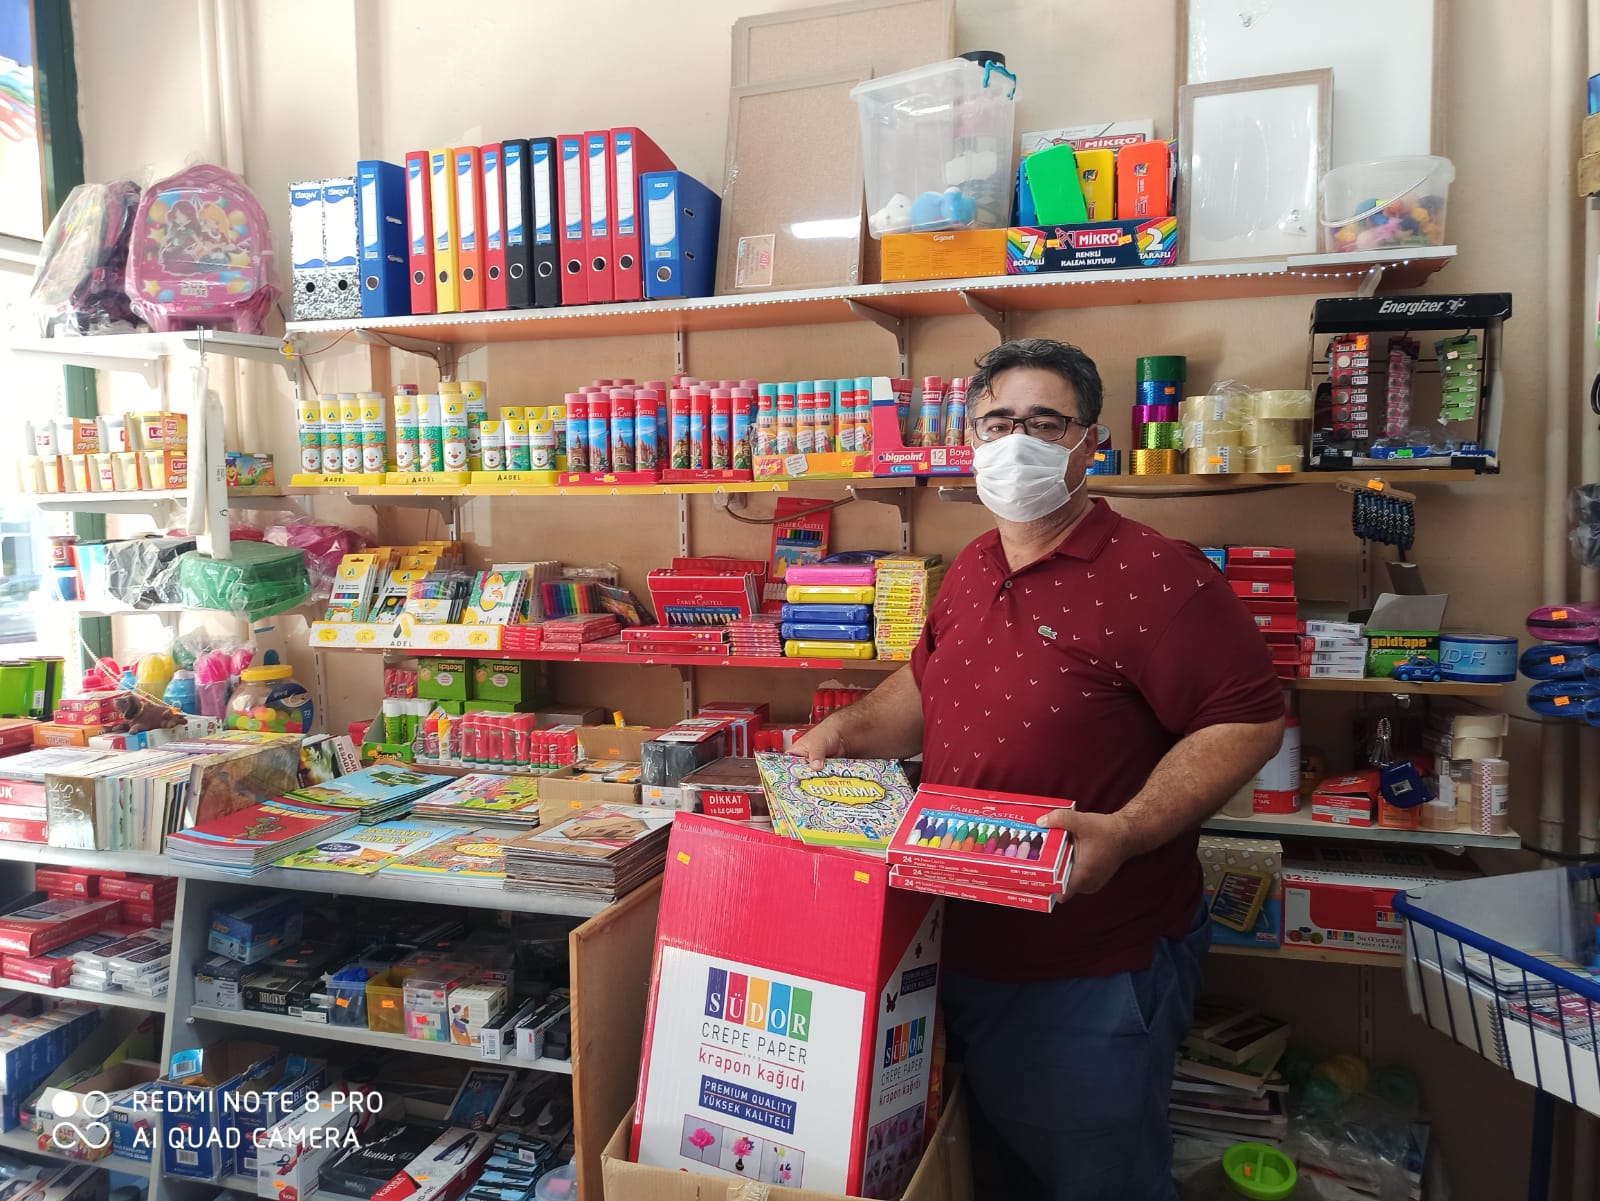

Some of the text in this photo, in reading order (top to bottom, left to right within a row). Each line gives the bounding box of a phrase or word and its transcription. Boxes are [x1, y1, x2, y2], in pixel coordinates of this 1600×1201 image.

[1078, 231, 1118, 246] MİKRO
[1145, 228, 1163, 250] 2
[1021, 235, 1038, 258] 7
[1061, 257, 1116, 267] KALEM KUTUSU
[1378, 300, 1442, 316] Energizer
[885, 452, 924, 463] bigpoint
[949, 449, 970, 457] Boya
[1371, 635, 1427, 649] goldtape
[709, 793, 742, 804] DİKKAT
[949, 804, 1025, 820] FABER-CASTELL
[902, 855, 912, 863] 24
[912, 868, 922, 876] 24
[904, 879, 914, 887] 24
[709, 992, 806, 1036] SÜDOR
[702, 1022, 807, 1065] CREPE PAPER
[699, 1047, 804, 1092] krapon kağıdı
[704, 1080, 793, 1114] PREMIUM QUALITY
[703, 1094, 791, 1129] YÜKSEK KALİTELİ
